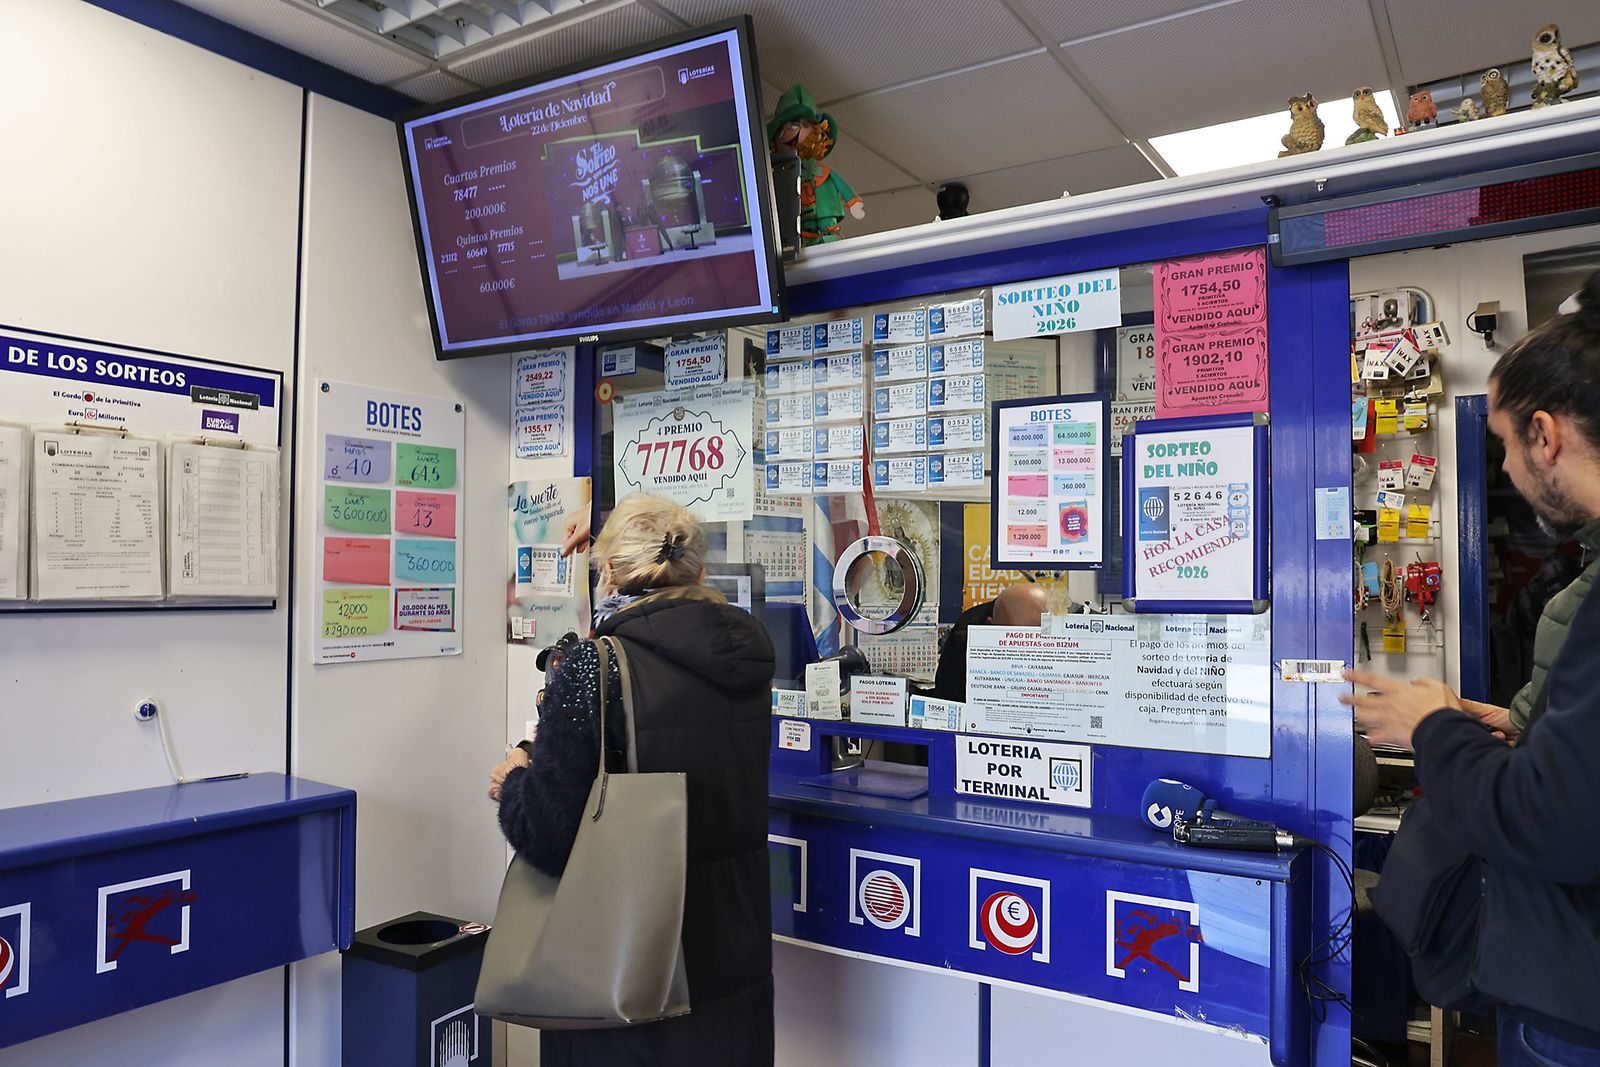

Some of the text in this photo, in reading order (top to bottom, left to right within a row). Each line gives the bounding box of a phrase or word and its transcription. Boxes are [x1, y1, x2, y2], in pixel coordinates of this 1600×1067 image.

[544, 103, 560, 118] de
[561, 81, 617, 114] Navidad
[531, 114, 588, 136] 22 Diciembre
[444, 159, 517, 186] Cuartos Premios
[453, 185, 478, 202] 78477
[582, 185, 599, 201] NOS
[464, 201, 507, 220] 200.000€
[456, 224, 524, 250] Quintos Premios
[466, 247, 488, 259] 60649
[1171, 262, 1254, 281] GRAN PREMIO
[480, 277, 516, 293] 60.000€
[998, 277, 1117, 306] SORTEO DEL
[1181, 279, 1241, 296] 1754,50
[1198, 293, 1226, 301] PRIMITIVA
[1201, 298, 1229, 306] ACIERTOS
[621, 301, 656, 314] Madrid
[1033, 299, 1080, 318] NIÑO
[1171, 310, 1223, 324] VENDIDO
[1036, 317, 1077, 333] 2026
[670, 343, 719, 357] GRAN PREMIO
[1172, 337, 1255, 354] GRAN PREMIO
[522, 359, 560, 371] GRAN PREMIO
[676, 355, 711, 368] 1754,50
[1183, 350, 1244, 367] 1902,10
[8, 345, 187, 388] DE LOS SORTEOS
[1197, 366, 1225, 374] PRIMITIVA
[525, 371, 554, 383] 2549,22
[670, 376, 700, 386] VENDIDO
[1200, 371, 1228, 379] ACIERTOS
[1174, 382, 1225, 396] VENDIDO
[61, 391, 82, 400] Gordo
[96, 395, 104, 403] de
[112, 398, 141, 408] Primitiva
[520, 392, 544, 401] VENDIDO
[68, 409, 126, 422] Euro Millones
[206, 416, 226, 424] EURO
[366, 400, 422, 432] BOTES
[520, 412, 559, 423] GRAN PREMIO
[1030, 408, 1072, 422] BOTES
[206, 422, 235, 431] DREAMS
[524, 424, 553, 434] 1355,17
[664, 422, 703, 435] PREMIO
[1012, 432, 1044, 441] 40.000.000
[1057, 430, 1092, 440] 64.500.000
[520, 445, 544, 453] VENDIDO
[637, 435, 725, 476] 77768
[1147, 441, 1212, 458] SORTEO
[346, 457, 372, 477] 40
[1013, 458, 1042, 466] 3.600.000
[1057, 456, 1091, 465] 13.000.000
[1143, 458, 1218, 479] DEL NIÑO
[653, 471, 708, 485] VENDIDO AQUÍ
[1062, 482, 1087, 491] 360.000
[513, 495, 529, 514] La
[530, 483, 557, 507] suerte
[1173, 490, 1223, 501] 52646
[412, 508, 433, 528] 13
[1234, 522, 1244, 530] 20
[1013, 533, 1042, 541] 1.290.000
[1143, 514, 1233, 560] HOY LA CASA
[1148, 531, 1241, 578] RECOMIENDA
[1177, 566, 1209, 579] 2026
[1065, 622, 1090, 631] Lotería
[1104, 624, 1135, 633] Nacional
[1008, 640, 1042, 648] APUESTAS
[1129, 639, 1246, 653] El pago de los premios del
[1142, 653, 1233, 663] sorteo de de
[1136, 665, 1226, 677] Navidad y del NIÑO
[1151, 679, 1223, 692] efectuará según
[1124, 690, 1239, 705] disponibilidad de efectivo
[927, 703, 946, 712] 18564
[1138, 705, 1207, 717] caja. Pregunten
[968, 740, 1043, 760] LOTERIA
[987, 762, 1023, 778] POR
[961, 778, 1050, 801] TERMINAL
